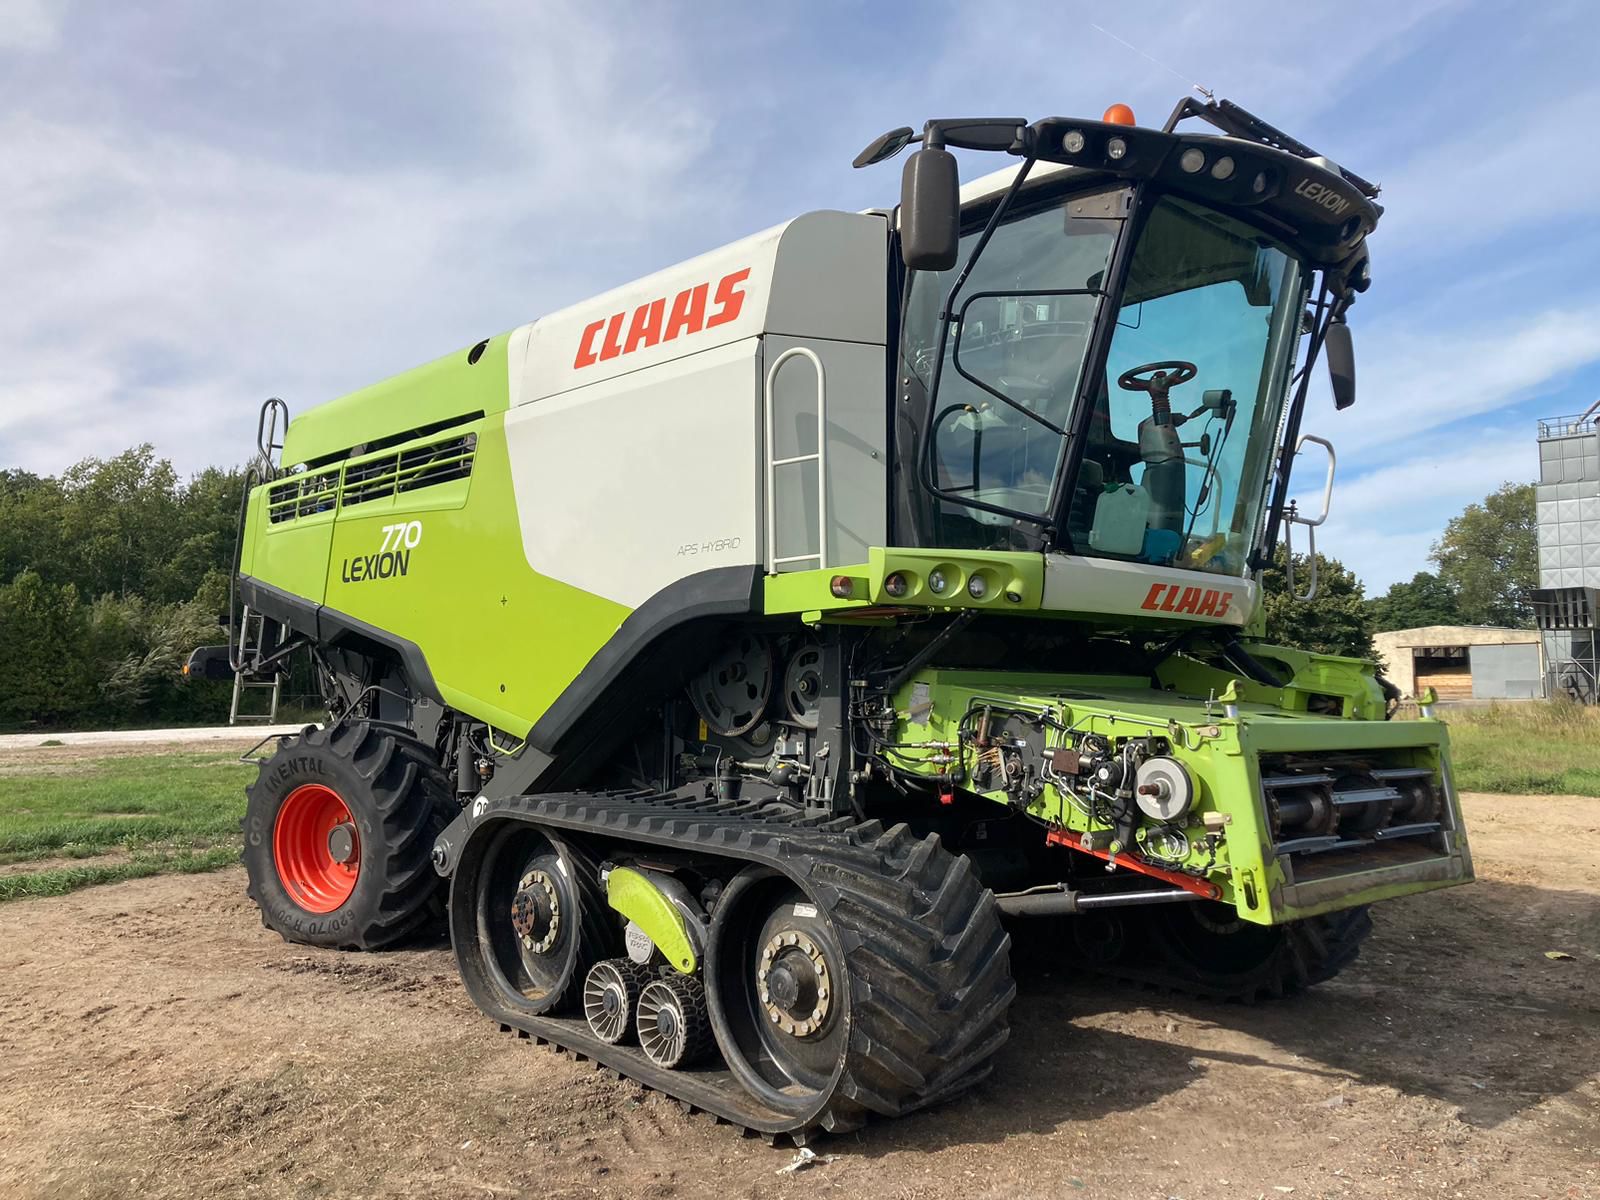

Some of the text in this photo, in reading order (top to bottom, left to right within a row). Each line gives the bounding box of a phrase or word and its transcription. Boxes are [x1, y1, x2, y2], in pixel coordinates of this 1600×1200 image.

[1295, 178, 1350, 215] LEXION
[573, 267, 751, 369] CLAAS
[380, 520, 422, 553] 770
[676, 537, 741, 556] APS HYBRID
[342, 549, 411, 583] LEXION
[1140, 583, 1233, 618] CLAAS
[249, 756, 328, 847] COINENTAL
[277, 909, 356, 936] 620/70 R 30
